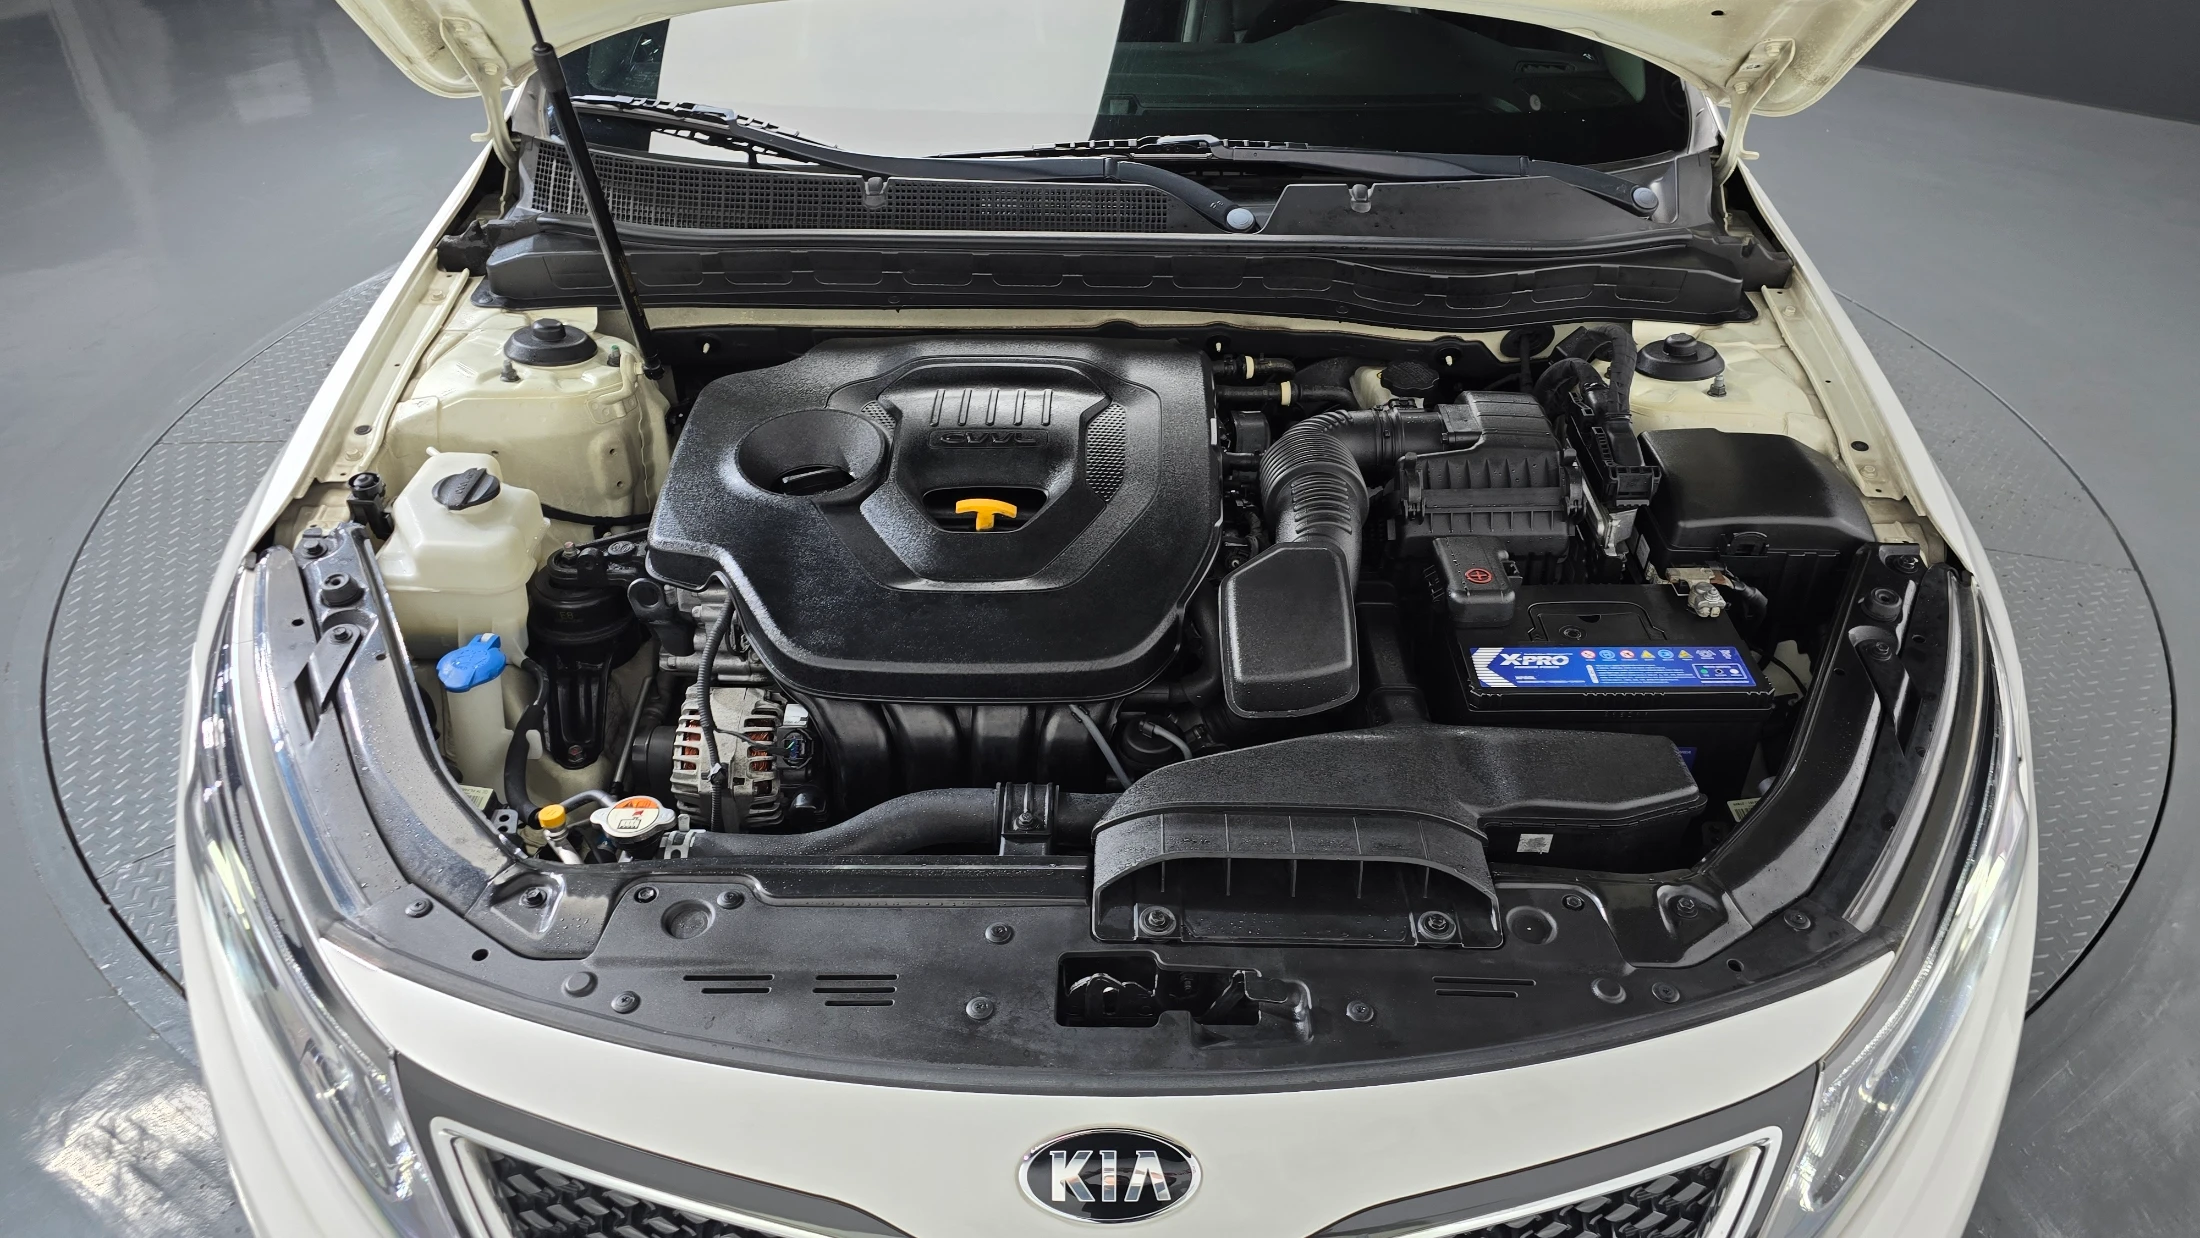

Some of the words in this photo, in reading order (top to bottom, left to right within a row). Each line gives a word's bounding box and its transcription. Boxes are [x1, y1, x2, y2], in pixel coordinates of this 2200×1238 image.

[940, 432, 1037, 444] CVVL
[1500, 653, 1570, 666] X-PRO
[1049, 1150, 1172, 1203] KIA
